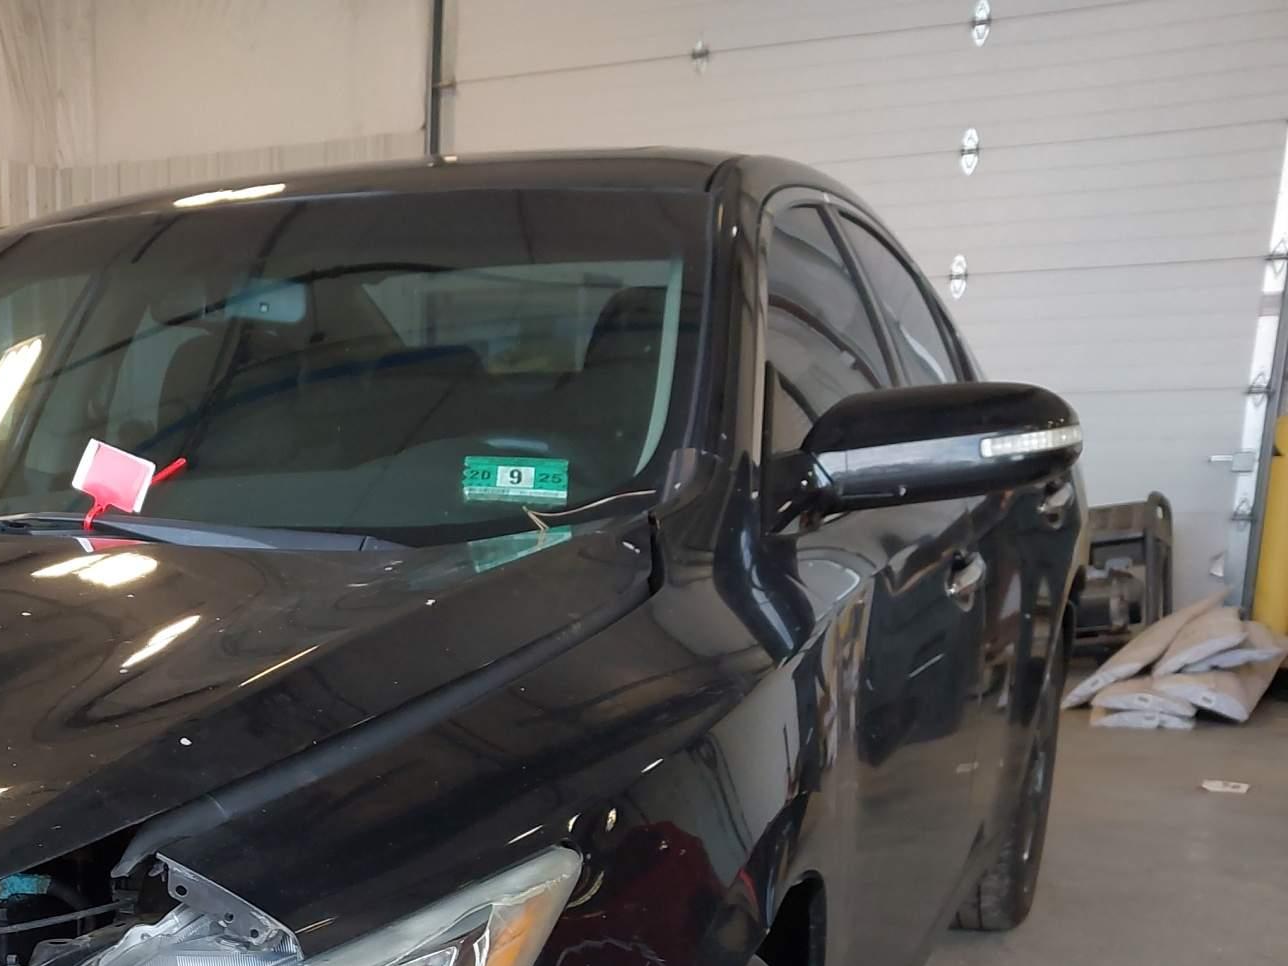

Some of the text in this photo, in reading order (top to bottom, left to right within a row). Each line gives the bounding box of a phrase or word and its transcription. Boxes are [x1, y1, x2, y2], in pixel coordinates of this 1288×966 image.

[469, 469, 562, 485] 20 9 25
